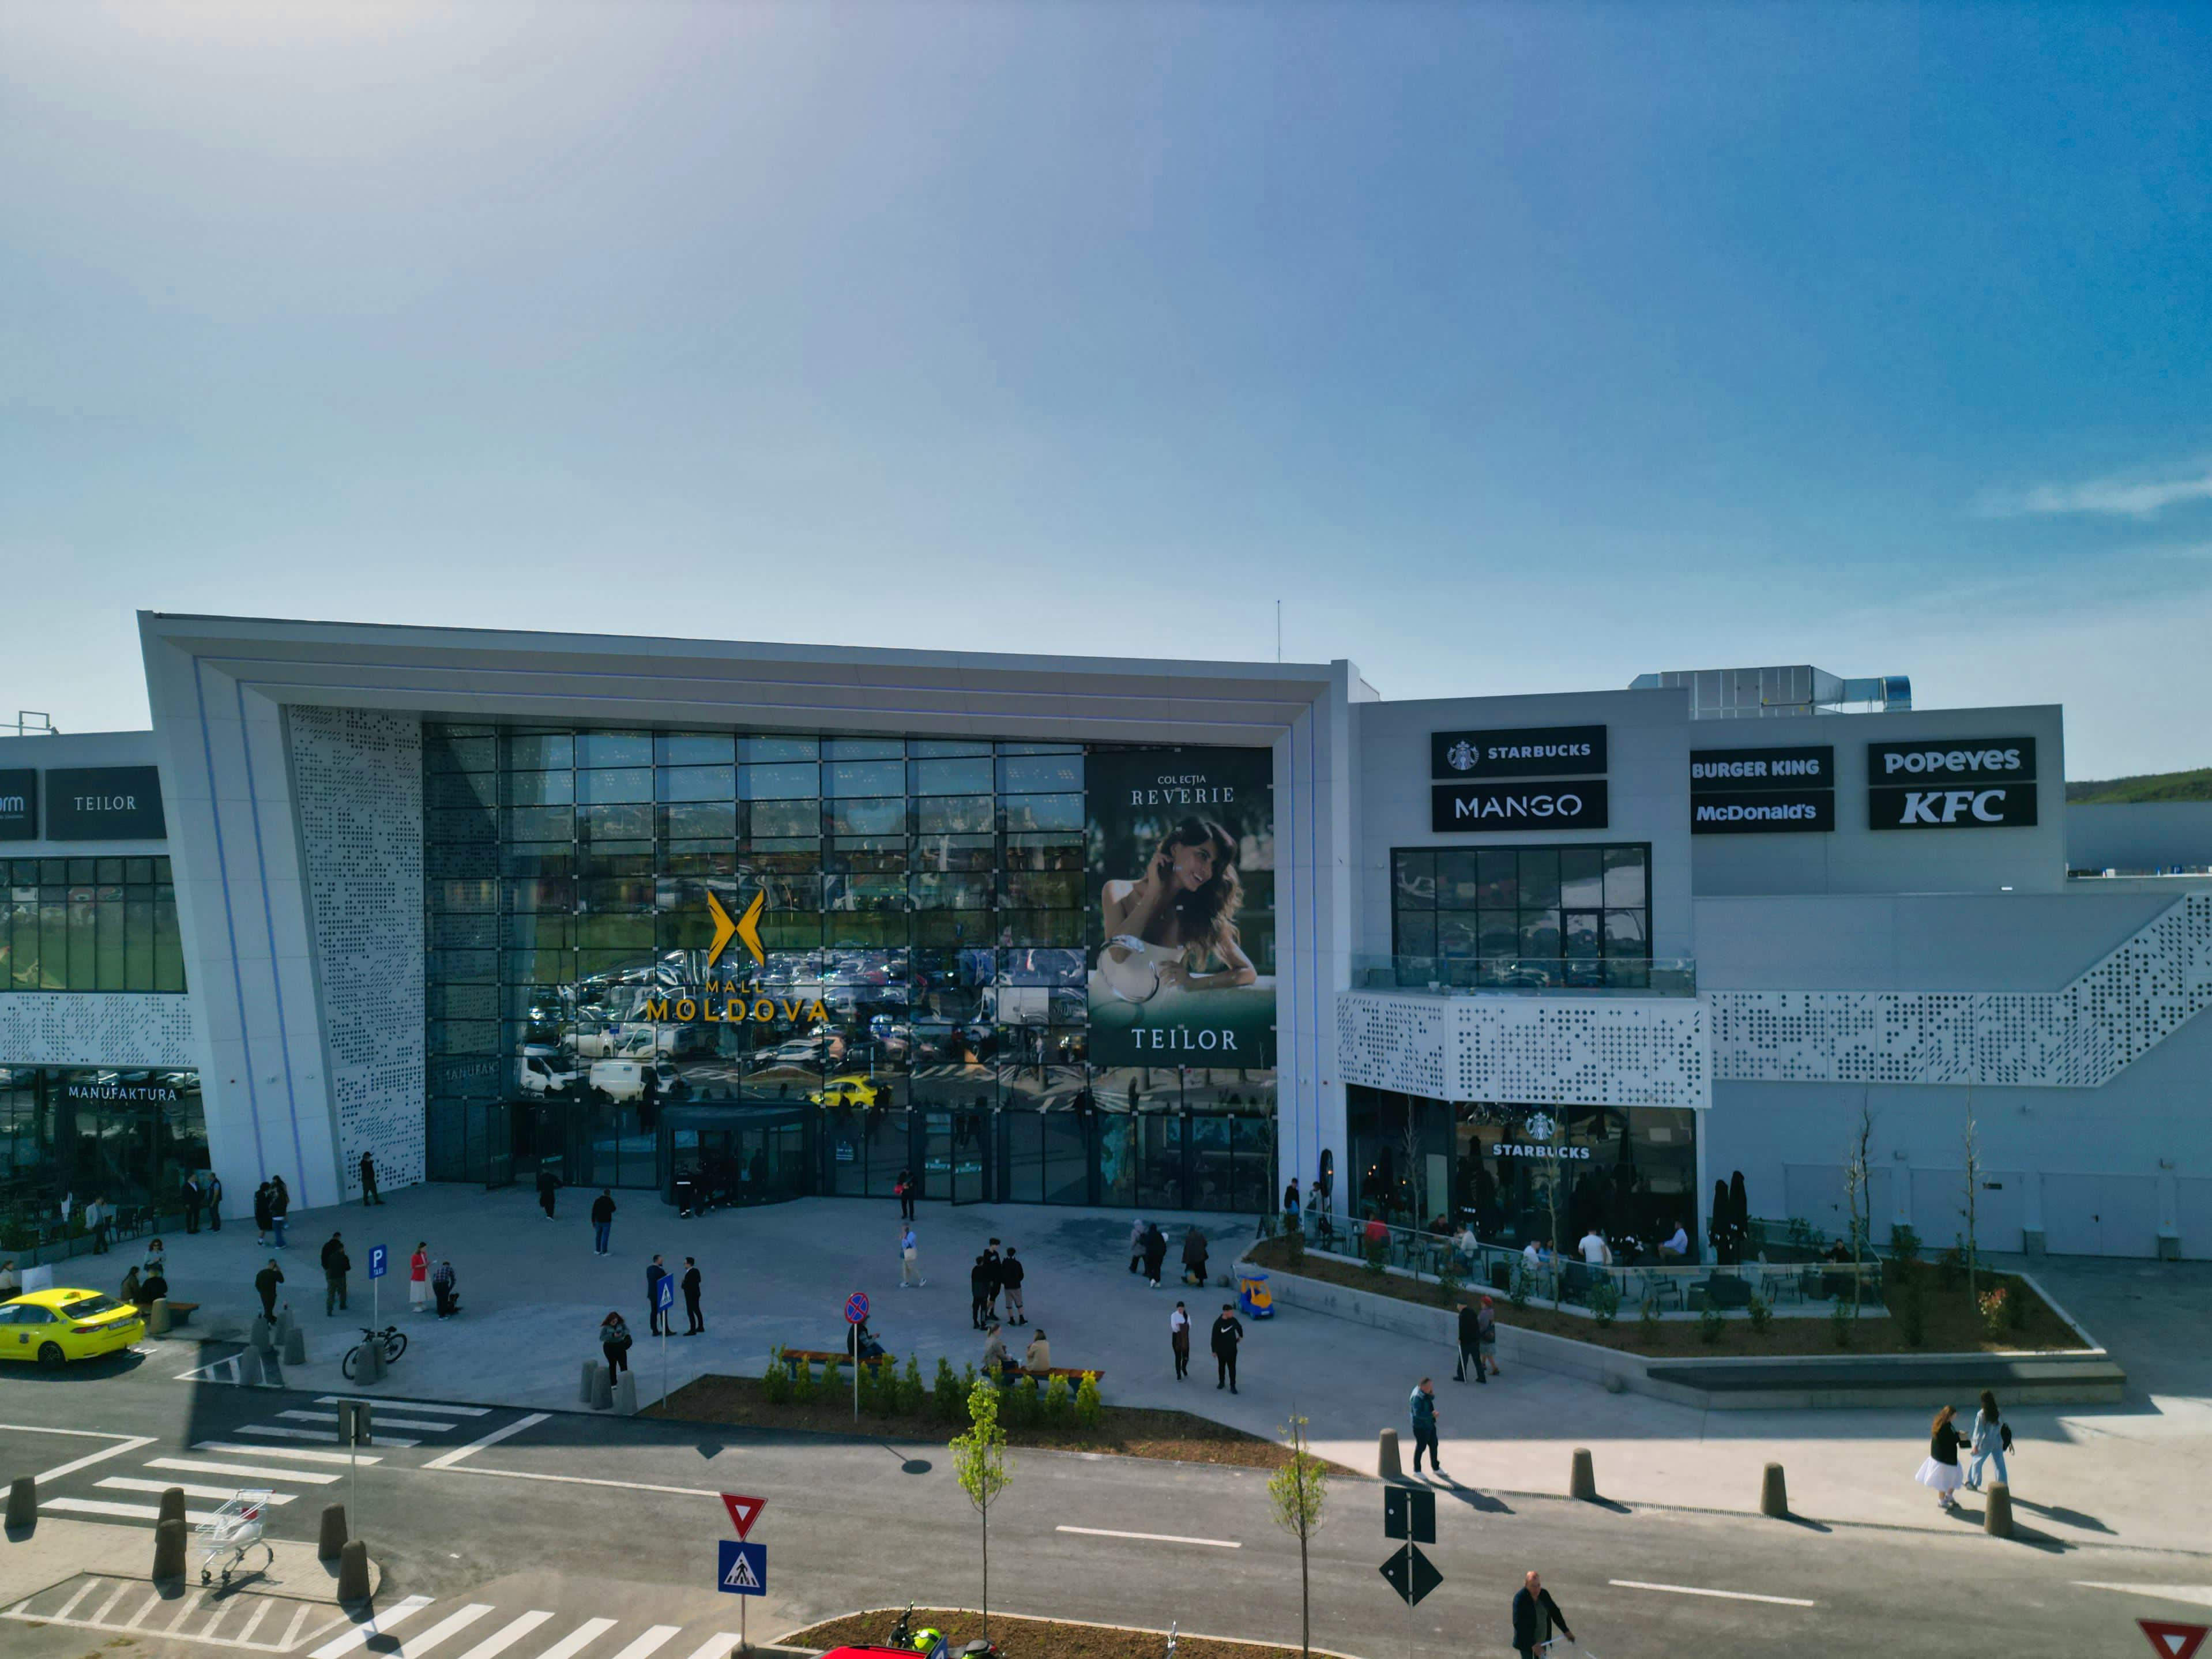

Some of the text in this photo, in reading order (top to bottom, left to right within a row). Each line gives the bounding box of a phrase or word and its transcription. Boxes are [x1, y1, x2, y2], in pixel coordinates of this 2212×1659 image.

[1488, 744, 1591, 759] STARBUCKS
[1692, 759, 1820, 778] BURGER KING
[74, 796, 136, 811] TEILOR
[1131, 787, 1234, 806] REVERIE
[1455, 794, 1582, 819] MANGO
[1696, 804, 1816, 821] McDonald's
[1899, 789, 2006, 824] KFC
[706, 980, 765, 994] MALL
[646, 999, 830, 1022] MOLDOVA
[1131, 1029, 1238, 1050] TEILOR
[69, 1086, 177, 1101] MANUFAKTURA
[1492, 1144, 1590, 1159] STARBUCKS
[373, 1250, 383, 1268] P
